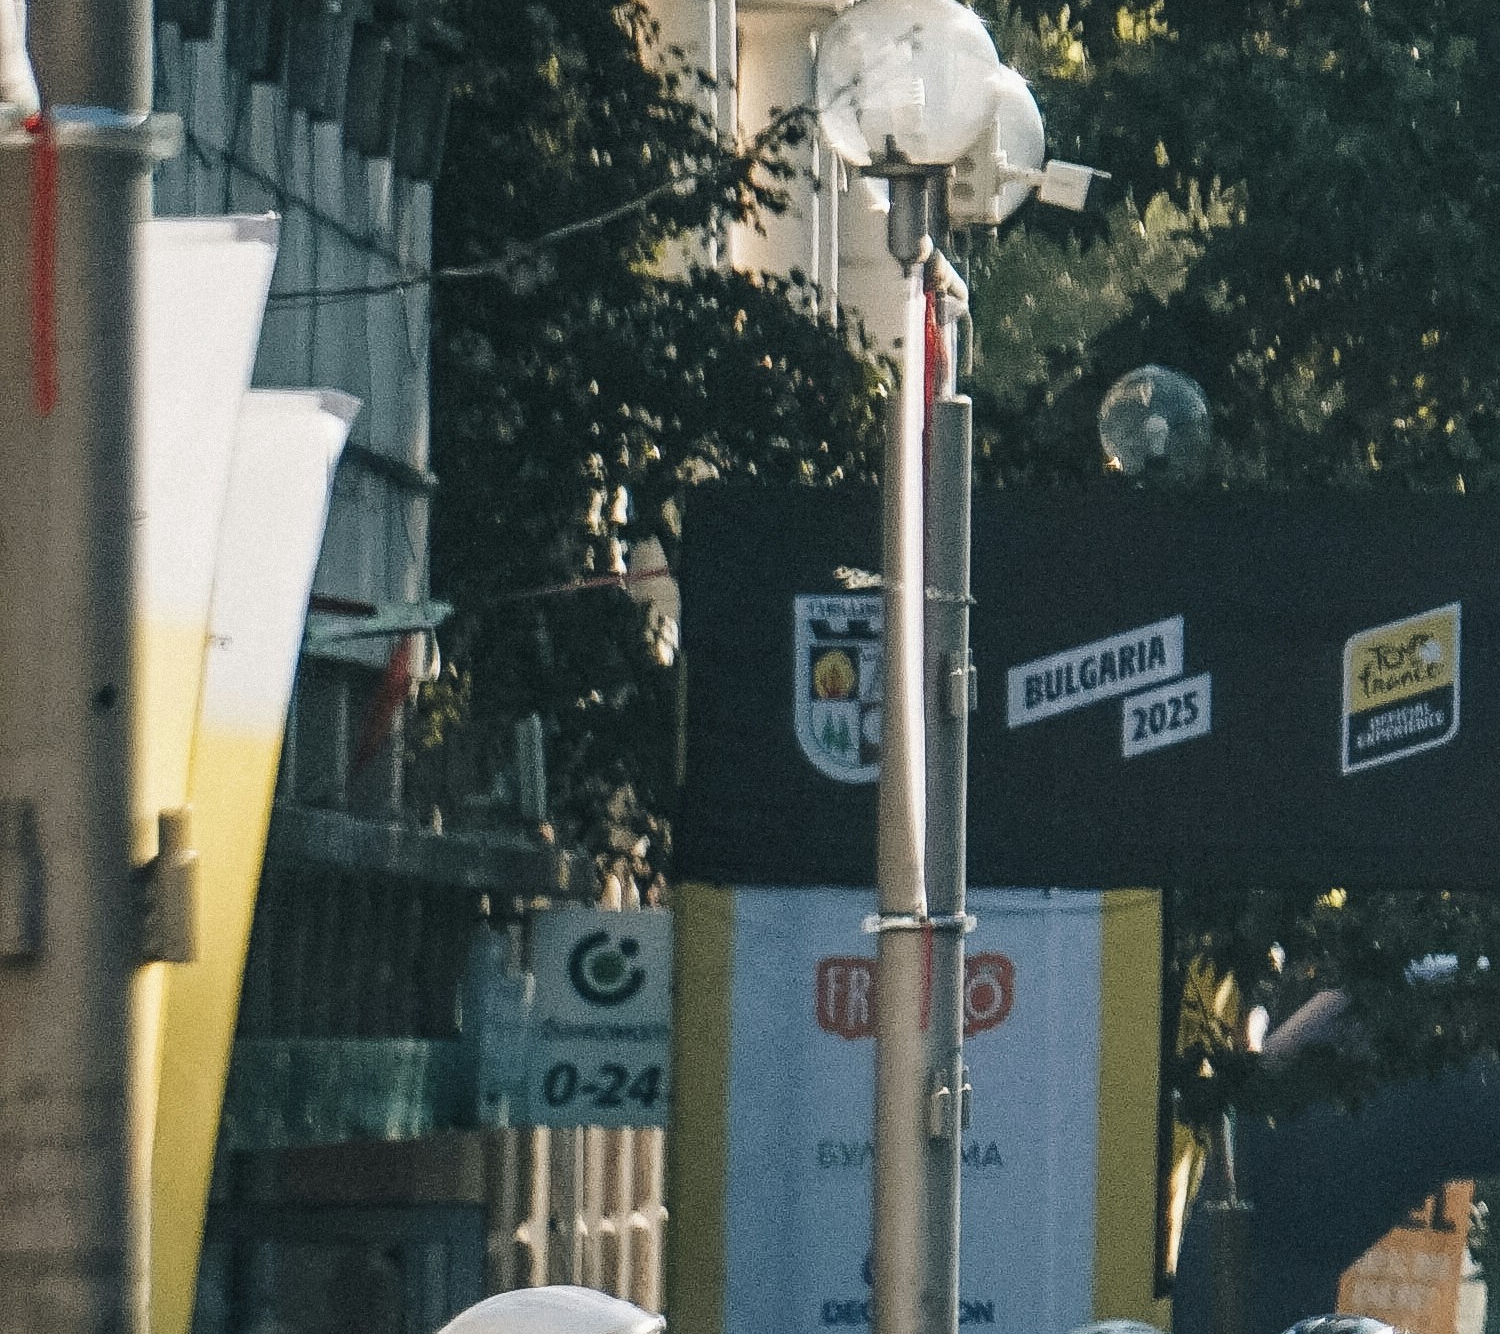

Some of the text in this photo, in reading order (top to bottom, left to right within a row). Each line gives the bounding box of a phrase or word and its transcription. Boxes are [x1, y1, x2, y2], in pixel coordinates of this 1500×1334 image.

[1024, 635, 1167, 708] BULGARIA
[1131, 692, 1200, 740] 2025
[543, 1062, 661, 1108] 0-24
